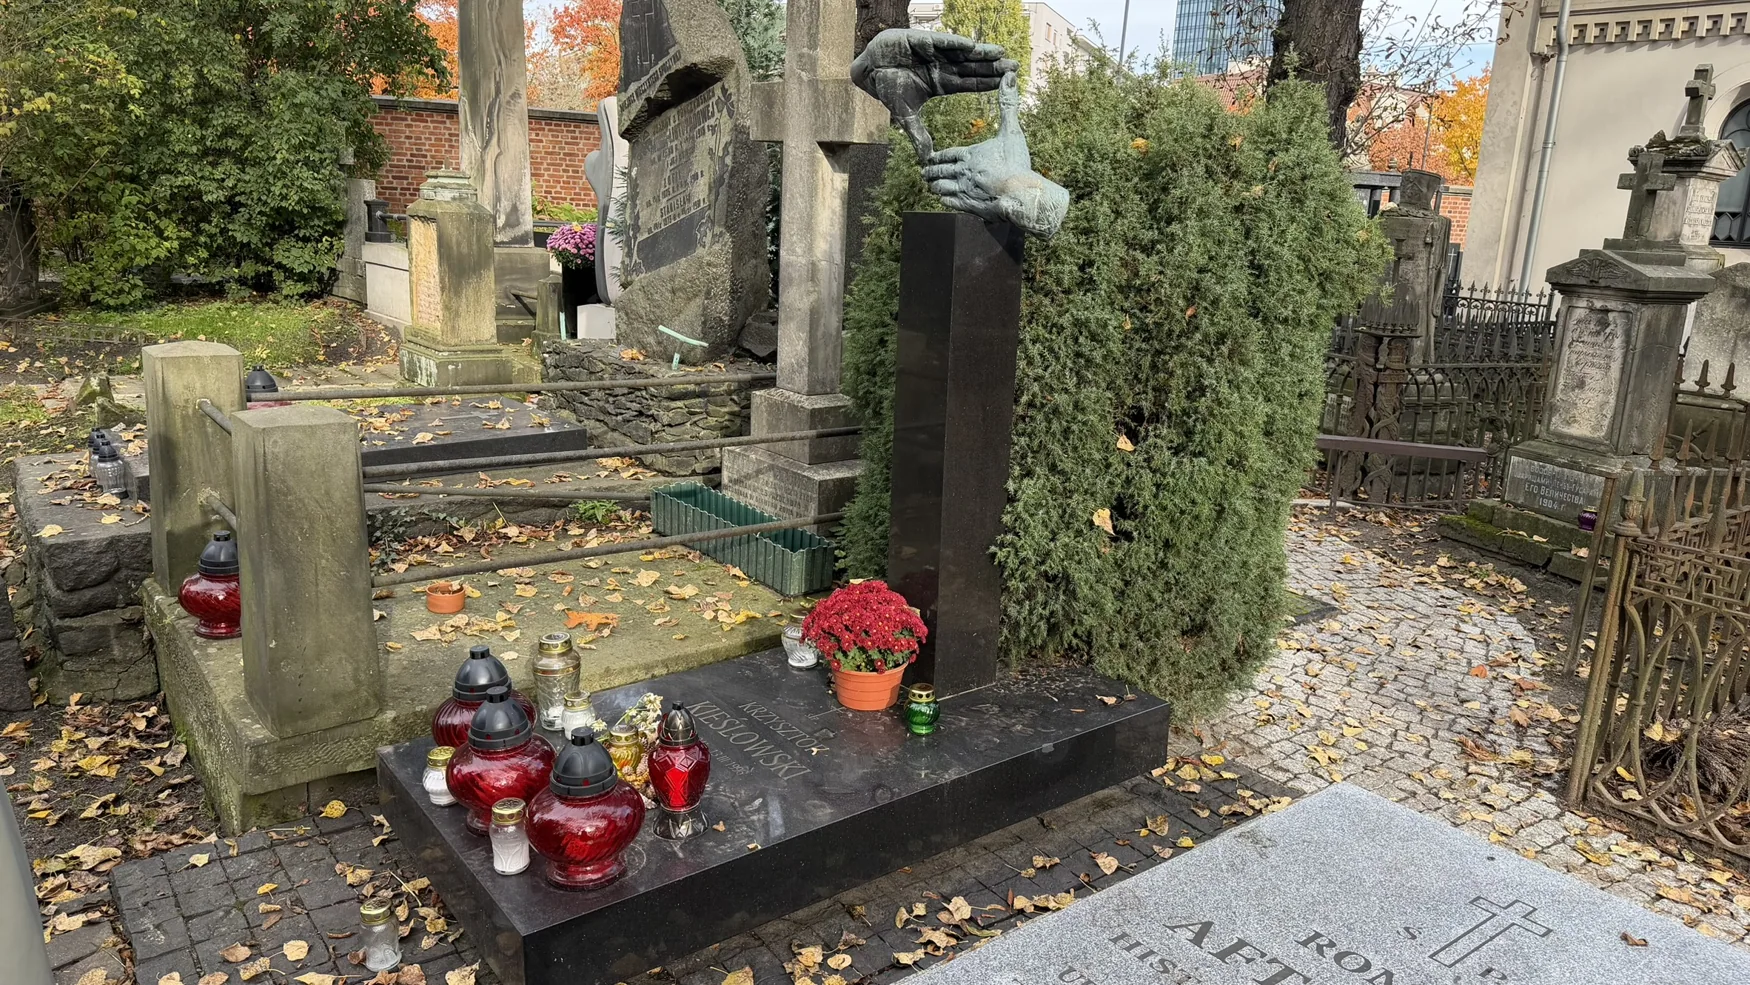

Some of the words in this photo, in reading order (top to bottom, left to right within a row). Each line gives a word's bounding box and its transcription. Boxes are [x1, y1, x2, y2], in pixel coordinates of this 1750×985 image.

[1539, 497, 1558, 510] 1904
[686, 700, 812, 780] KIEŚLOWSKI
[738, 701, 829, 752] KRZYSZTOF
